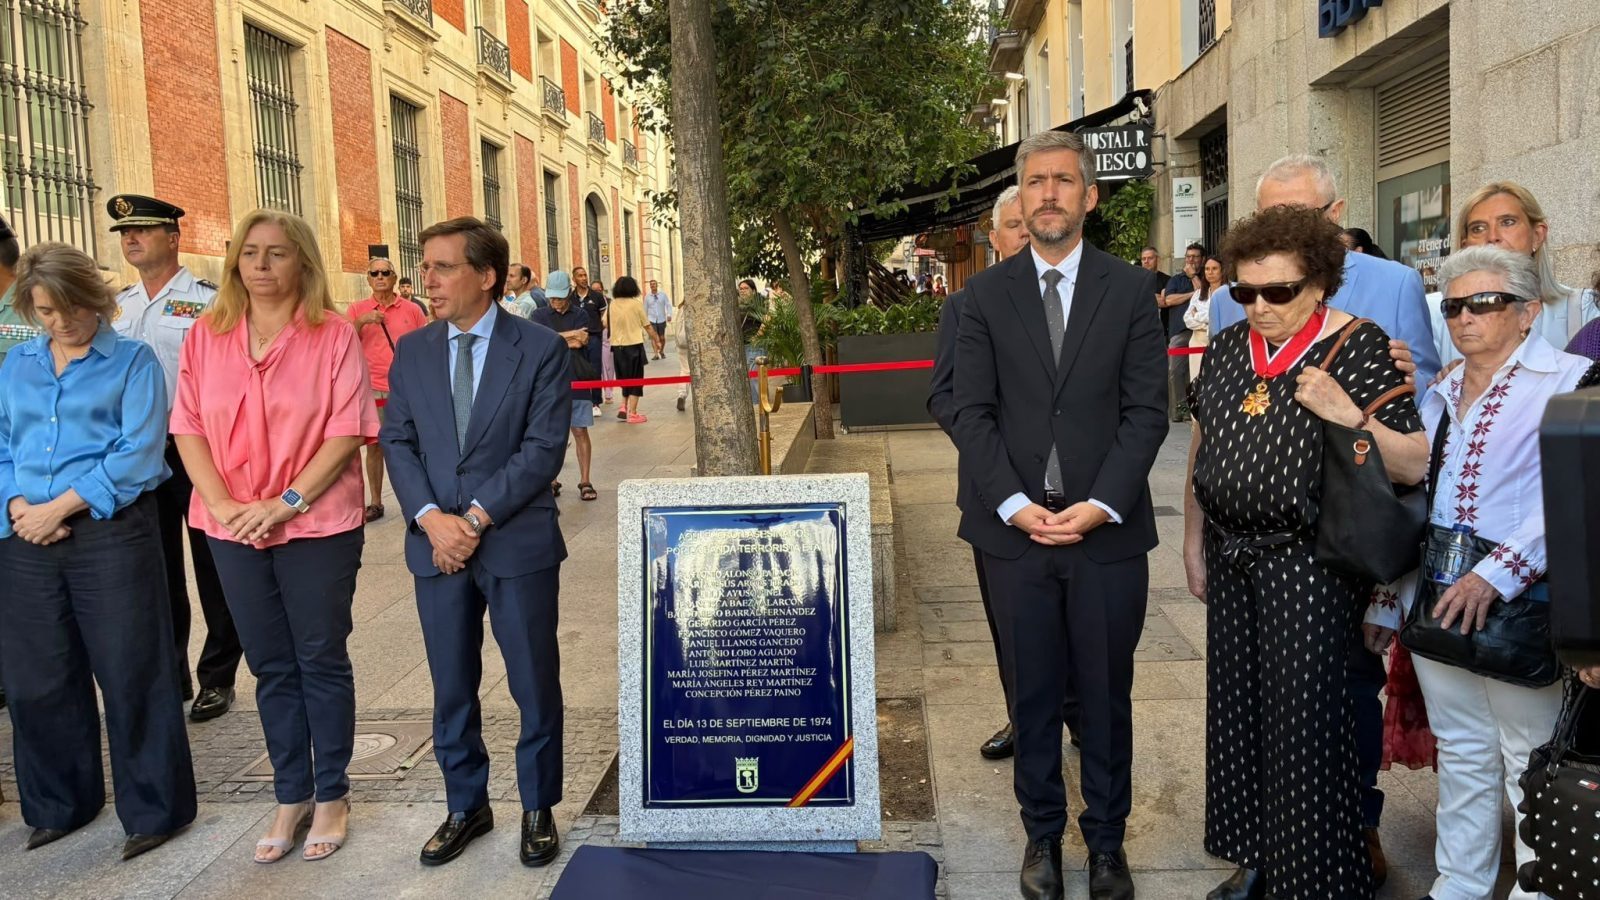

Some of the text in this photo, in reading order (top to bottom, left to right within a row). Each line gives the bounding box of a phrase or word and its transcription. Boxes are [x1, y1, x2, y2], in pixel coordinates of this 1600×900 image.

[1083, 130, 1148, 149] HOSTAL R.
[1096, 151, 1147, 172] IESCO
[738, 543, 800, 553] TERRORISTA
[802, 543, 821, 552] ETA
[758, 588, 784, 597] NEL
[724, 608, 762, 617] BARRAL
[763, 606, 816, 616] FERNÁNDEZ
[688, 616, 797, 628] GERARDO GARCÍA PÉREZ
[678, 627, 806, 638] FRANCISCO GÓMEZ VAQUERO
[682, 638, 803, 648] MANUEL LLANOS GANCEDO
[688, 648, 797, 658] ANTONIO LOBO AGUADO
[689, 656, 794, 668] LUIS MARTÍNEZ MARTÍN
[667, 666, 817, 678] MARÍA JOSEFINA PÉREZ MARTÍNEZ
[672, 676, 813, 688] MARÍA ÁNGELES REY MARTÍNEZ
[685, 687, 801, 698] CONCEPCIÓN PÉREZ PAINO
[663, 717, 832, 728] EL DÍA 13 DE SEPTIEMBRE DE 1974
[664, 733, 832, 744] VERDAD, MEMORIA, DIGNIDAD Y JUSTICIA
